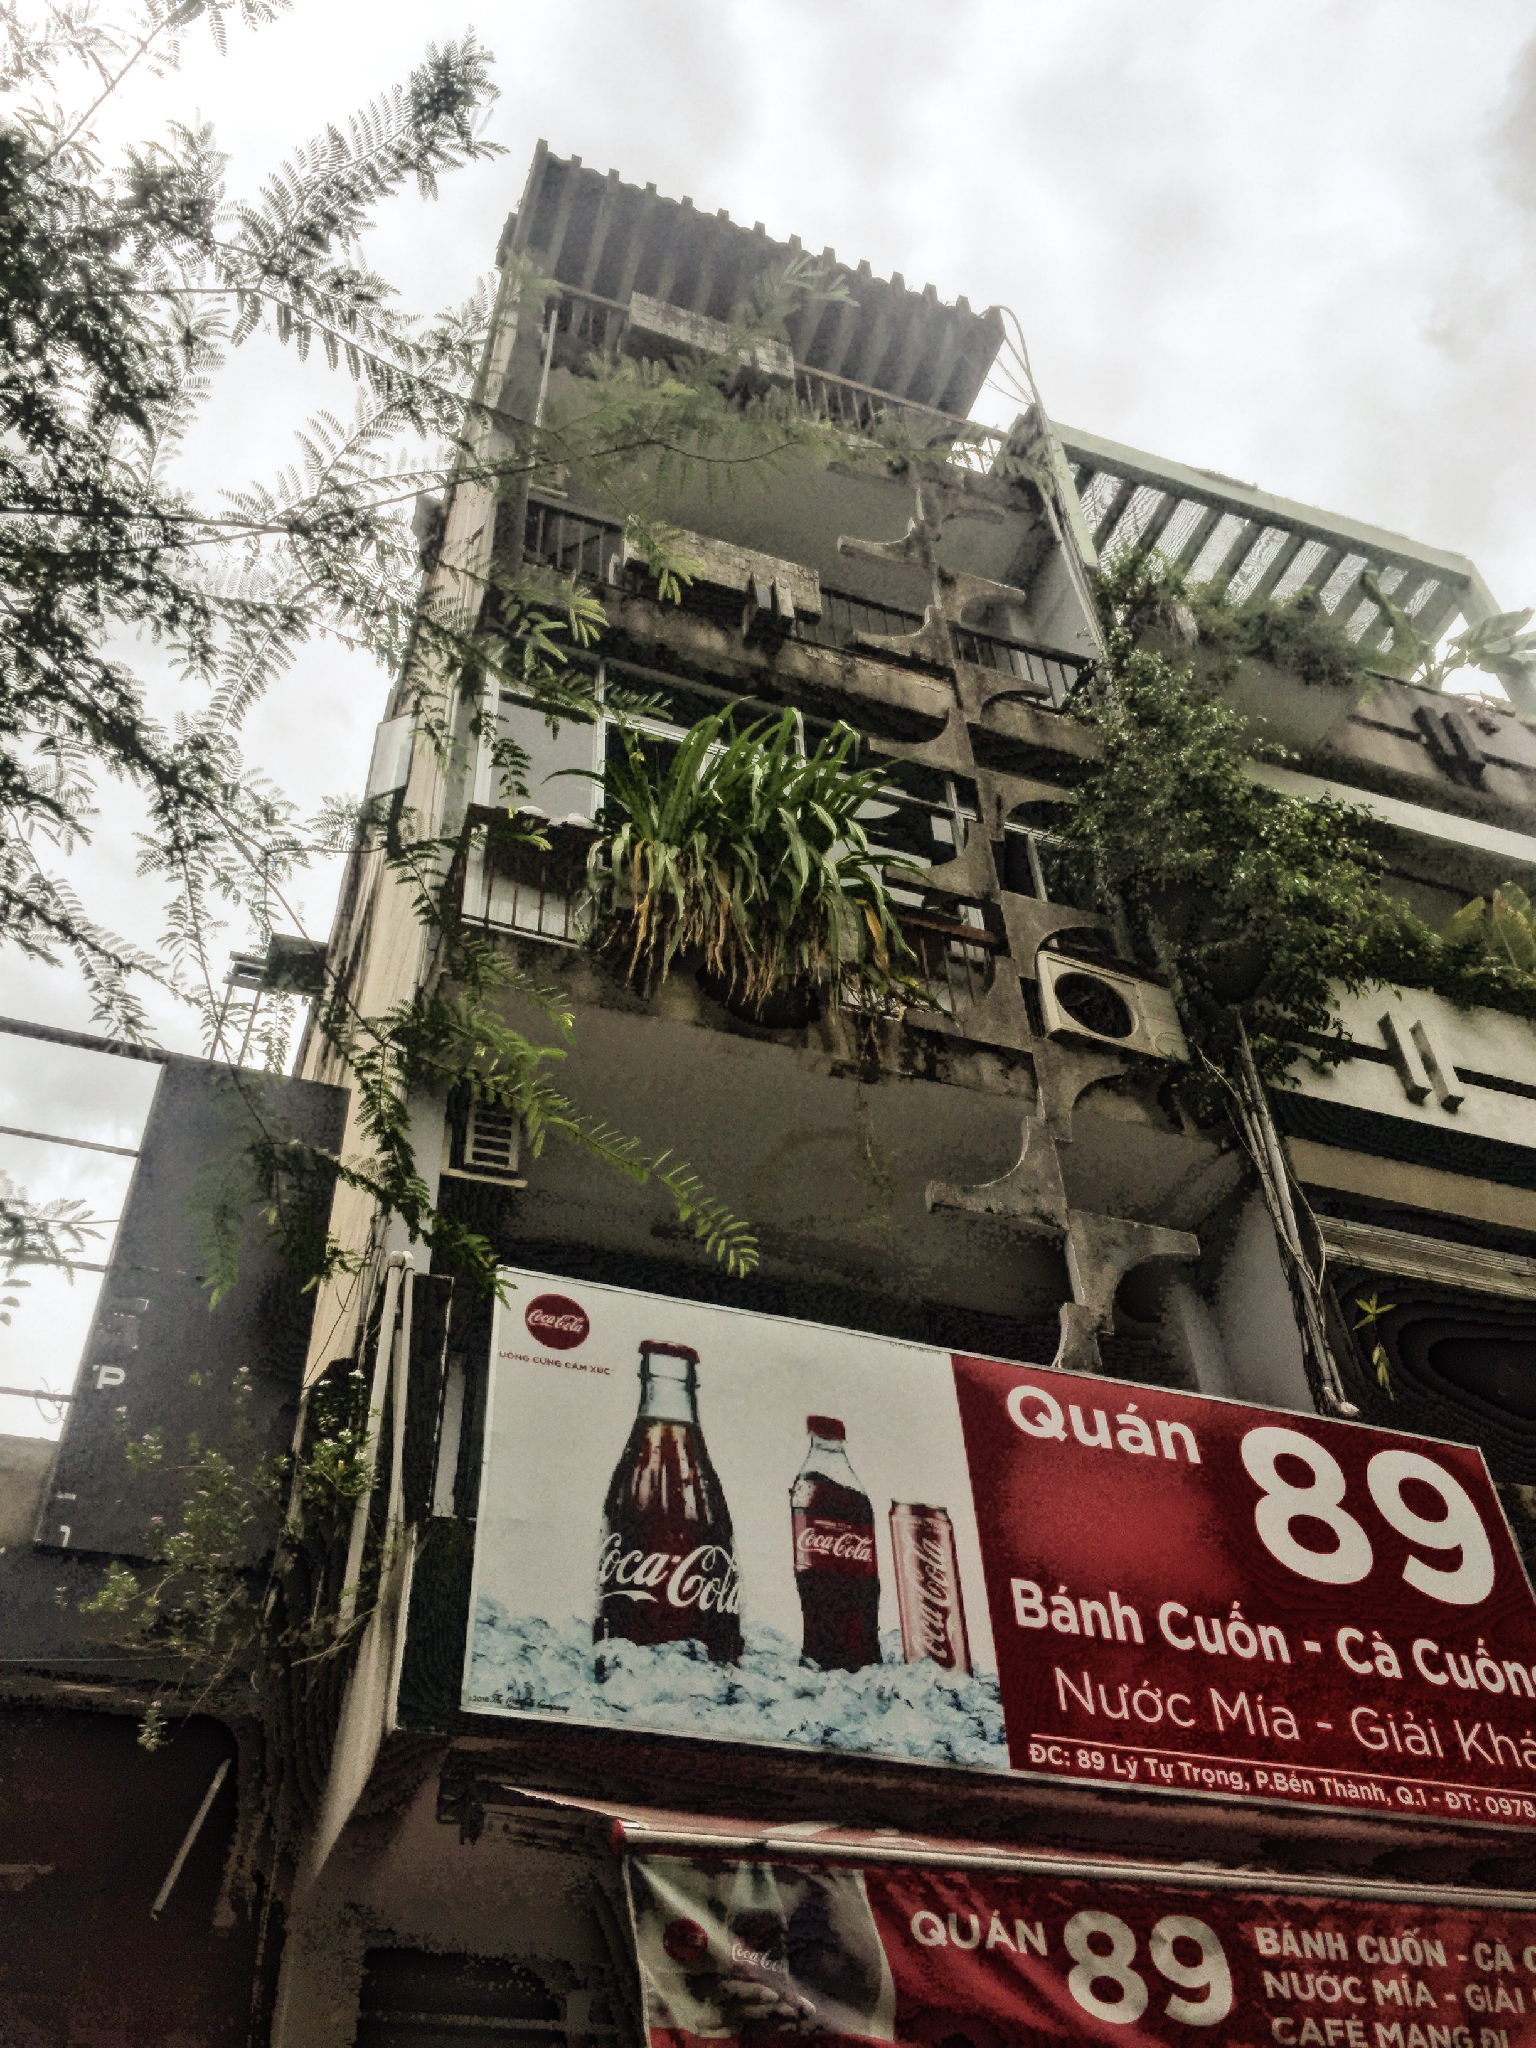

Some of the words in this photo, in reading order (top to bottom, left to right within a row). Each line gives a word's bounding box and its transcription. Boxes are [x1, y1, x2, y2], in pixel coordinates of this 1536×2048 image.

[527, 1308, 584, 1333] Coca-Cola
[1007, 1385, 1201, 1464] Quán
[1240, 1426, 1496, 1606] 89
[797, 1527, 873, 1563] Coca-Cola
[1010, 1577, 1144, 1645] Bánh
[1158, 1601, 1292, 1664] Cuốn
[1336, 1626, 1403, 1679] Cà
[1412, 1637, 1536, 1698] Cuốn
[1054, 1667, 1195, 1728] Nước
[1209, 1687, 1300, 1741] Mía
[1351, 1706, 1444, 1758] Giải
[1029, 1743, 1071, 1767] ĐC:
[1076, 1749, 1106, 1771] 89
[1111, 1753, 1139, 1780] Lý
[1143, 1757, 1174, 1784] Tự
[1177, 1761, 1250, 1791] Trọng,
[1319, 1777, 1392, 1806] Thành,
[1396, 1786, 1428, 1806] Q.1
[1445, 1791, 1482, 1812] ĐT:
[910, 1909, 1048, 1957] QUÁN
[1063, 1910, 1233, 2026] 89
[1254, 1921, 1349, 1961] BÁNH
[1357, 1927, 1447, 1967] CUỐN
[1473, 1937, 1515, 1973] CÀ
[1262, 1969, 1367, 2003] NƯỚC
[1372, 1973, 1438, 2009] MÍA
[1373, 2021, 1474, 2048] MANG
